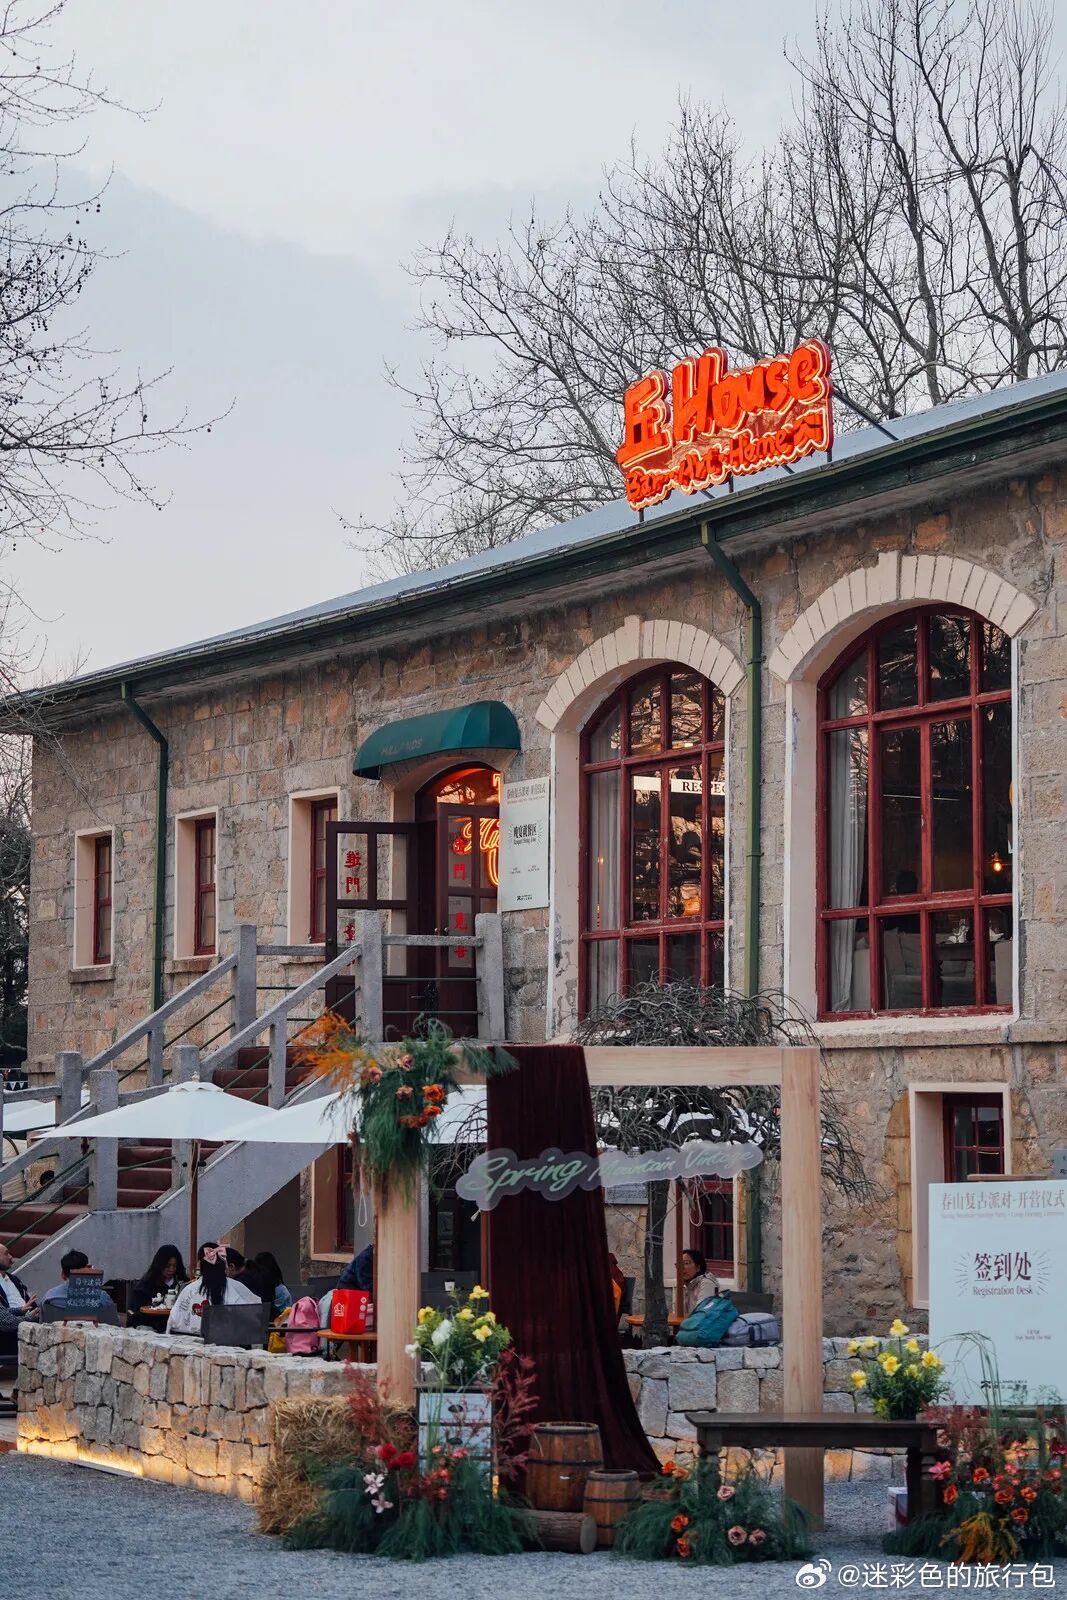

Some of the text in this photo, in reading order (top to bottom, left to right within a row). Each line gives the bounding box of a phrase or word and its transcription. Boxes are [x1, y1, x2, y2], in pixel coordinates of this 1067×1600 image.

[672, 345, 823, 442] House
[466, 1156, 588, 1200] Spring
[588, 1158, 677, 1182] Mountain
[685, 1149, 755, 1171] Vintage
[973, 1251, 1033, 1282] 签到处
[973, 1285, 1034, 1297] Registration Desk
